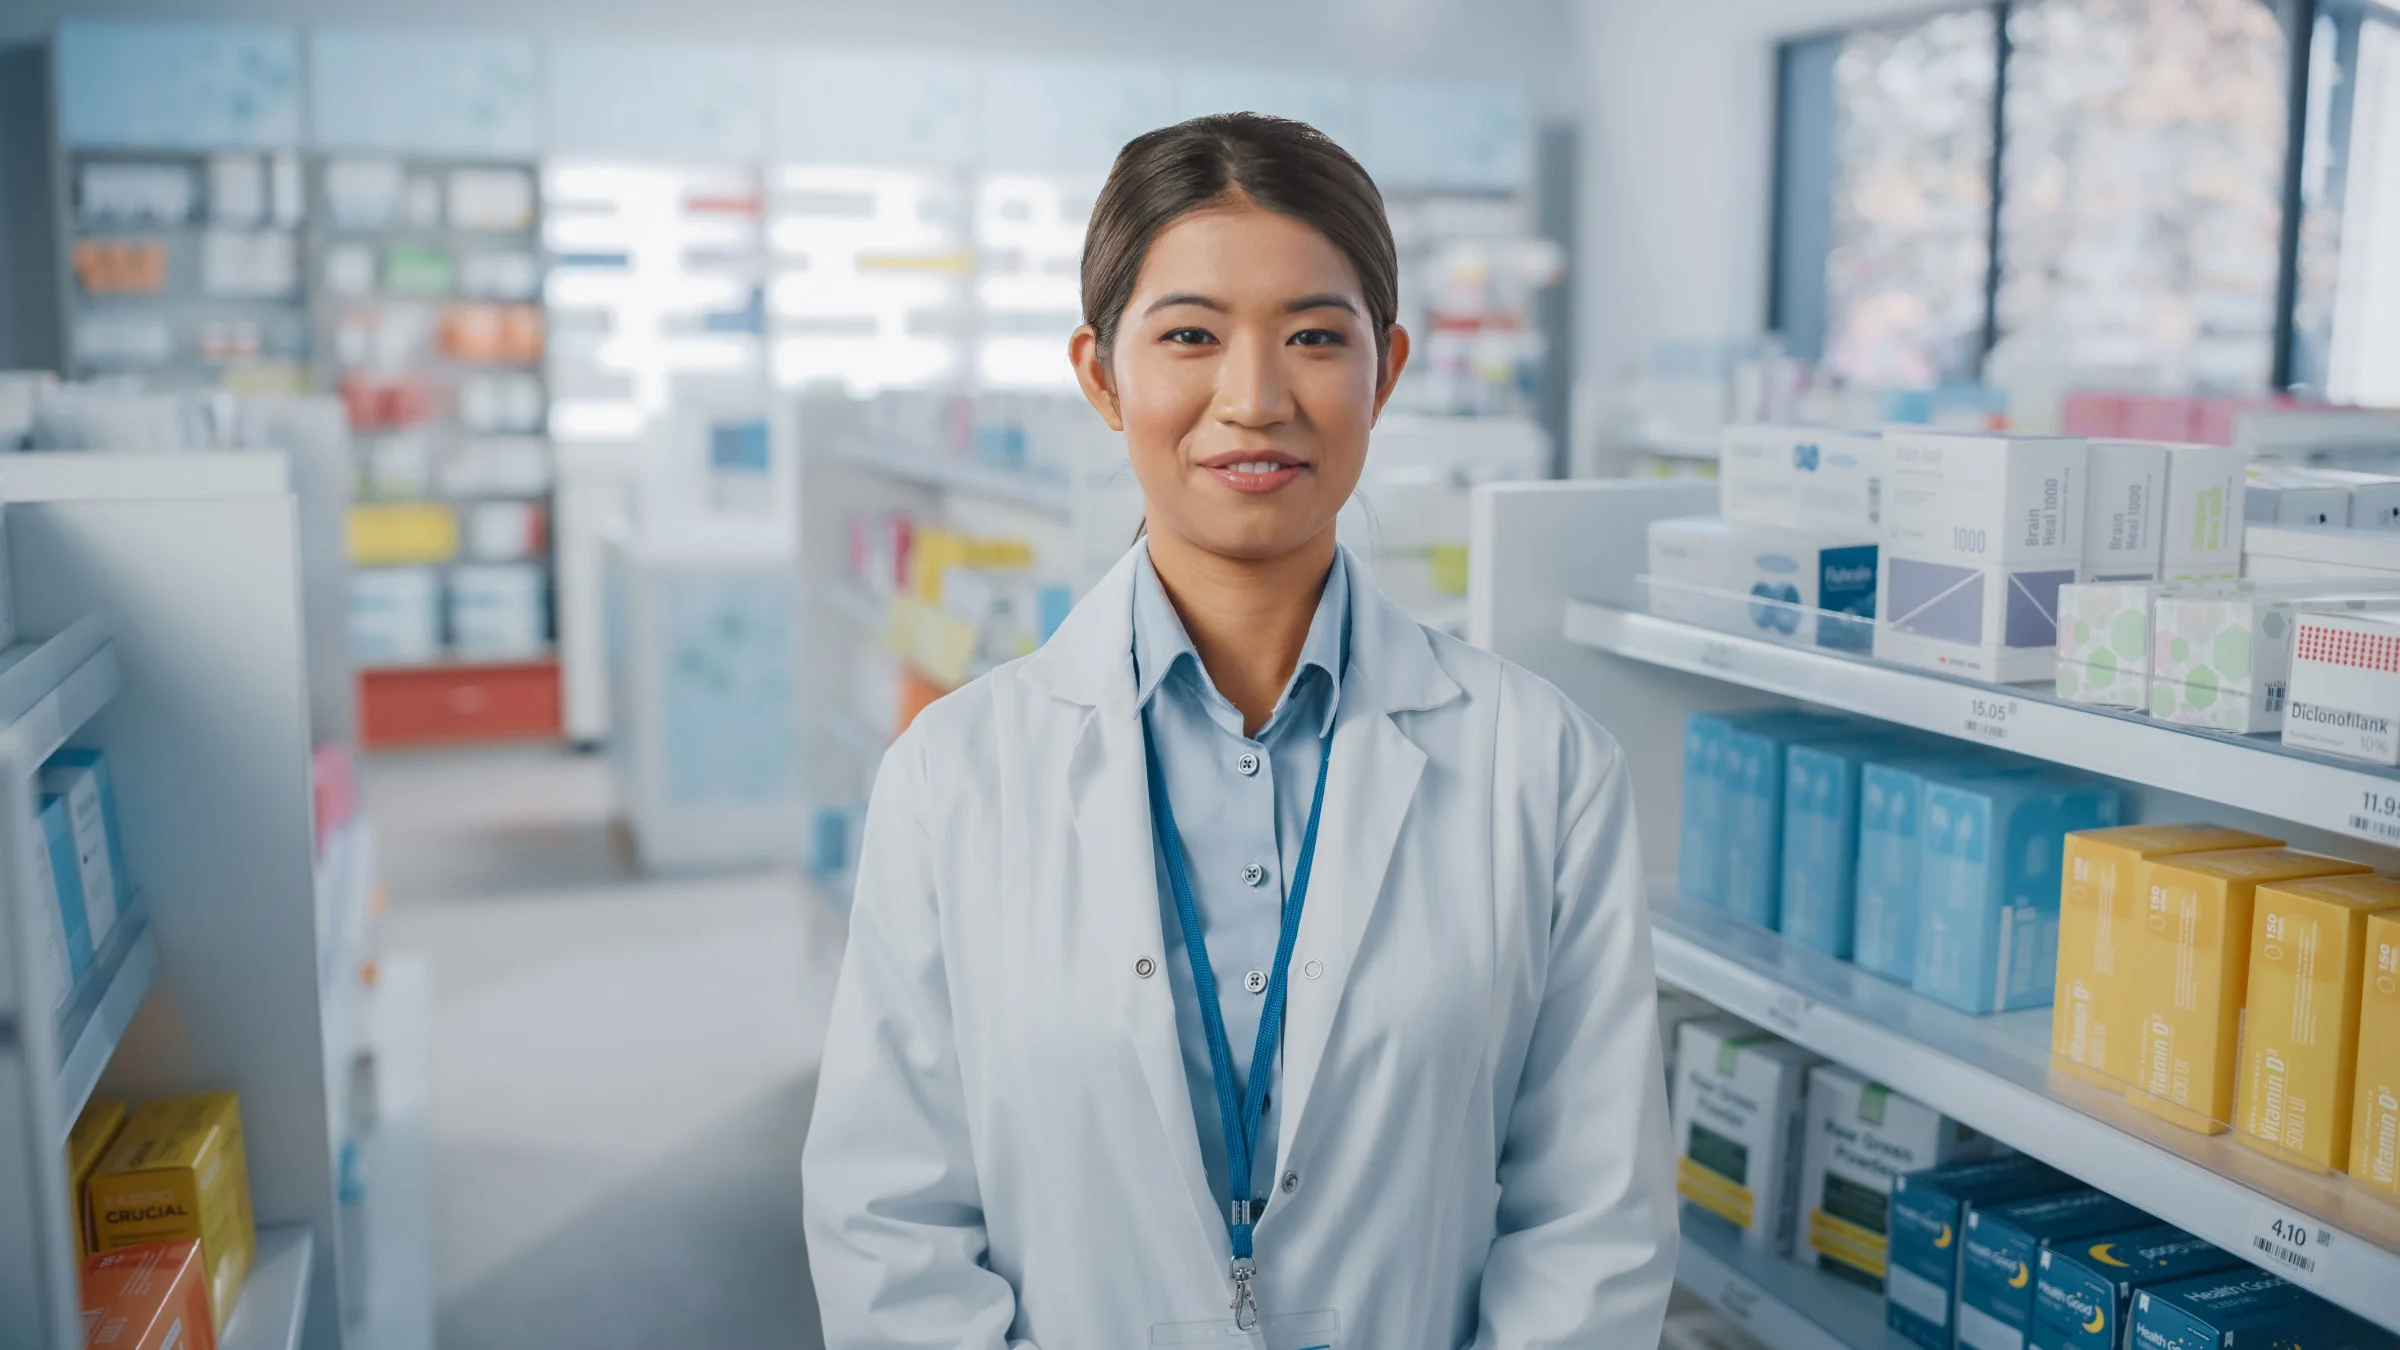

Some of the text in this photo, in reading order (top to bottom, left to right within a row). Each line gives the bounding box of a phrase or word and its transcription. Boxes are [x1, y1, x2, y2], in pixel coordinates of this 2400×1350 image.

[2042, 478, 2059, 547] Heal 1000
[2125, 484, 2142, 550] Heal 1000
[1953, 526, 1986, 554] 1000
[2025, 508, 2040, 547] Brain
[2109, 513, 2123, 550] Brain
[1972, 700, 2006, 721] 15.05
[2360, 735, 2389, 755] 10%
[2362, 791, 2400, 818] 11.9
[2150, 885, 2161, 911] 150
[2266, 913, 2278, 941] 150
[2378, 943, 2390, 971] 150
[2147, 1038, 2168, 1099] Vitamin
[2260, 1075, 2285, 1142] Vitamin
[2285, 1096, 2307, 1151] 5000 UI
[2372, 1111, 2397, 1184] Vitamin
[105, 1204, 188, 1224] CRUCIAL
[2271, 1218, 2307, 1248] 4.10
[2038, 1280, 2066, 1303] Health
[2065, 1293, 2093, 1319] Good
[2183, 1284, 2247, 1303] Health
[2136, 1322, 2168, 1349] Health
